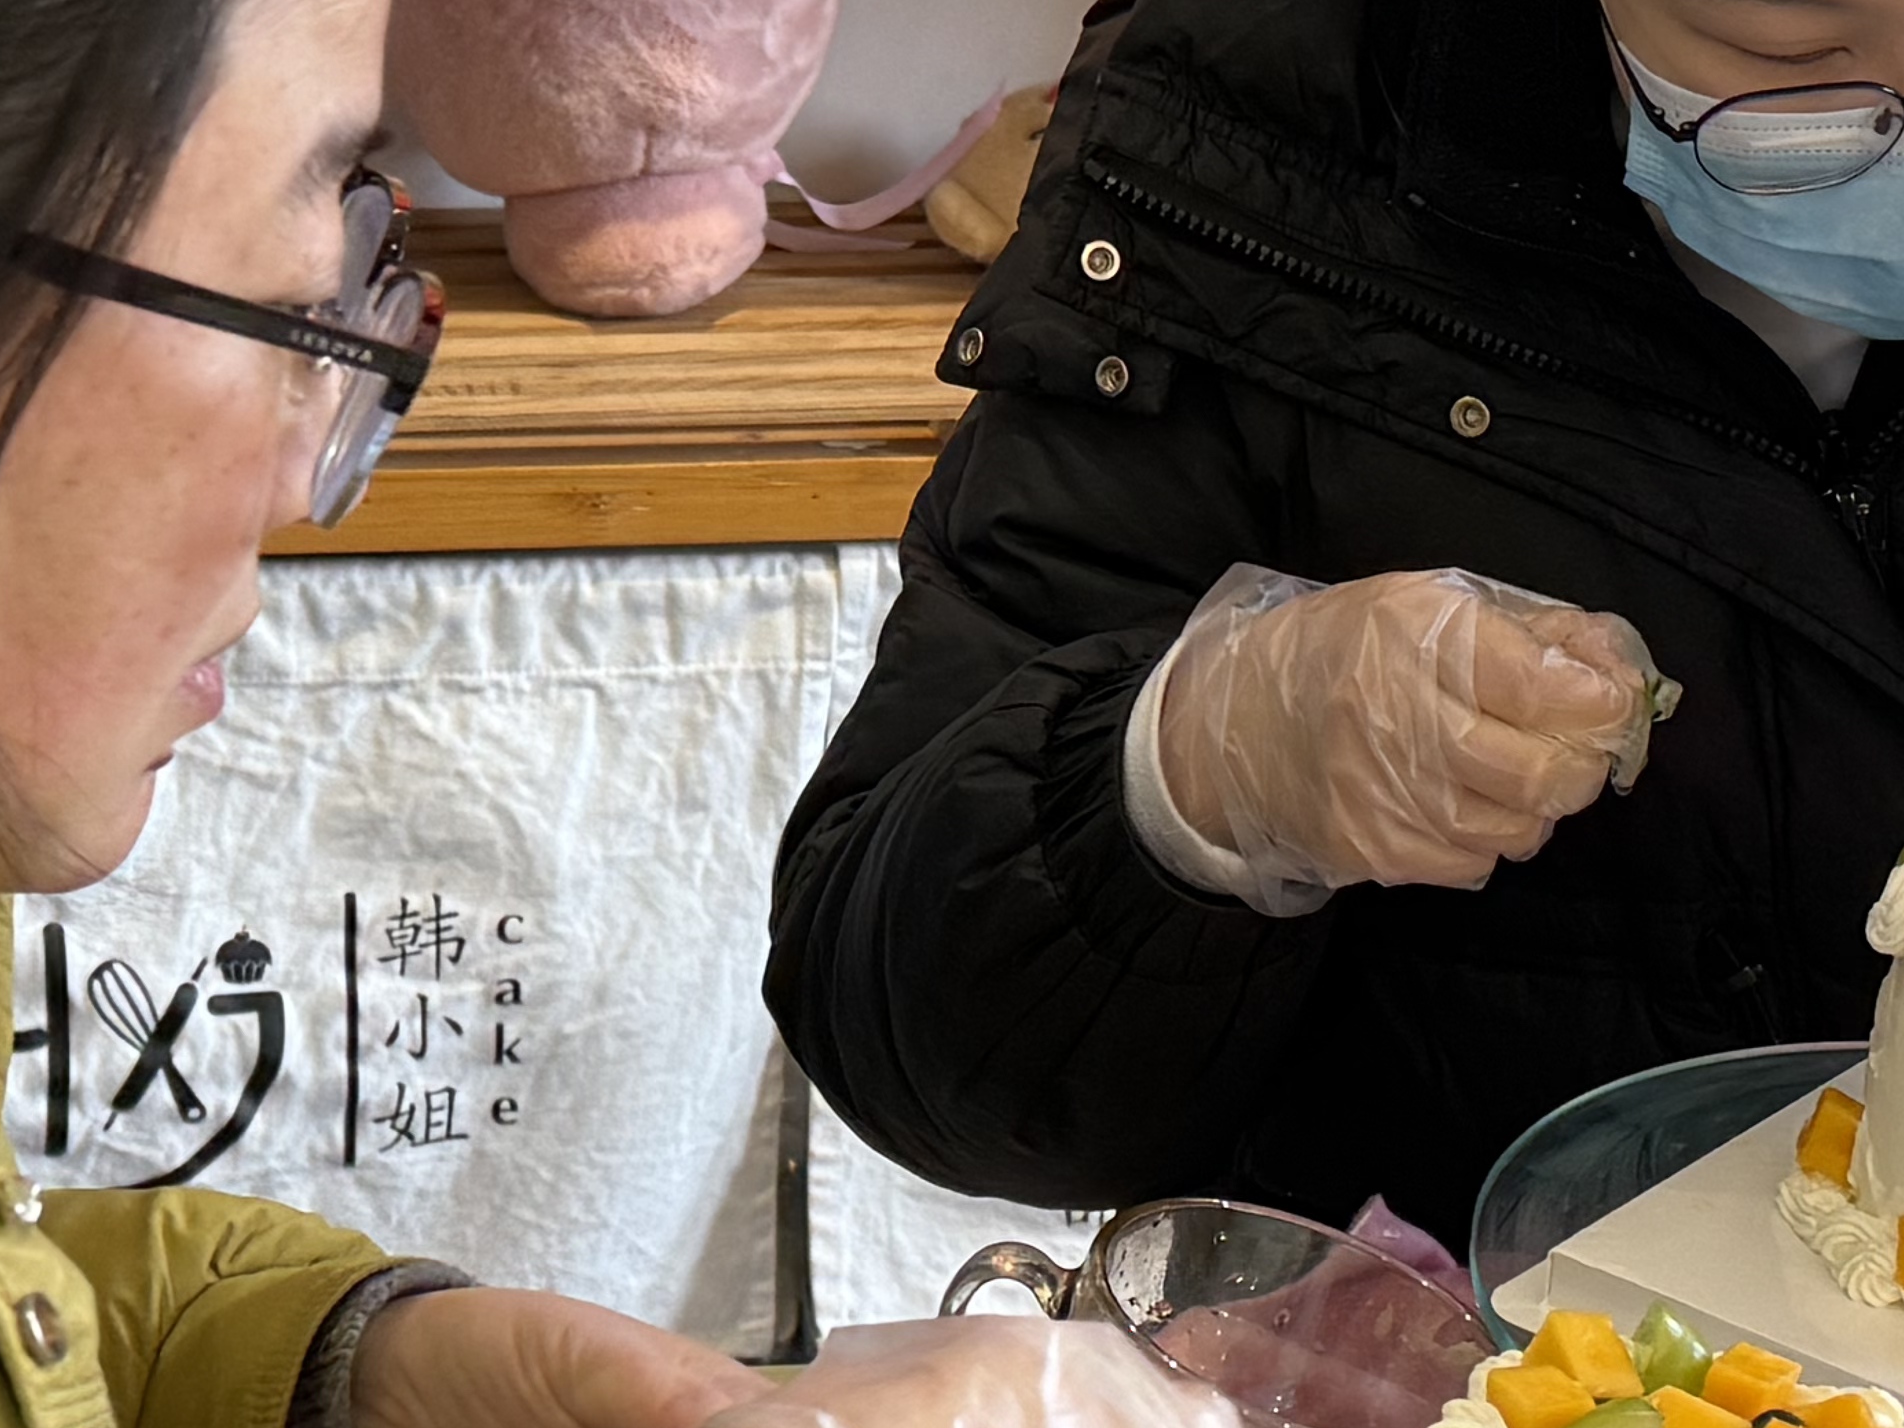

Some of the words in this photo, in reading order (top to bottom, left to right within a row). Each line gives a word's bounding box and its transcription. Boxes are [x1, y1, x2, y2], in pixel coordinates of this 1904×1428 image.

[373, 892, 469, 1154] 韩小姐
[490, 912, 525, 1127] cake
